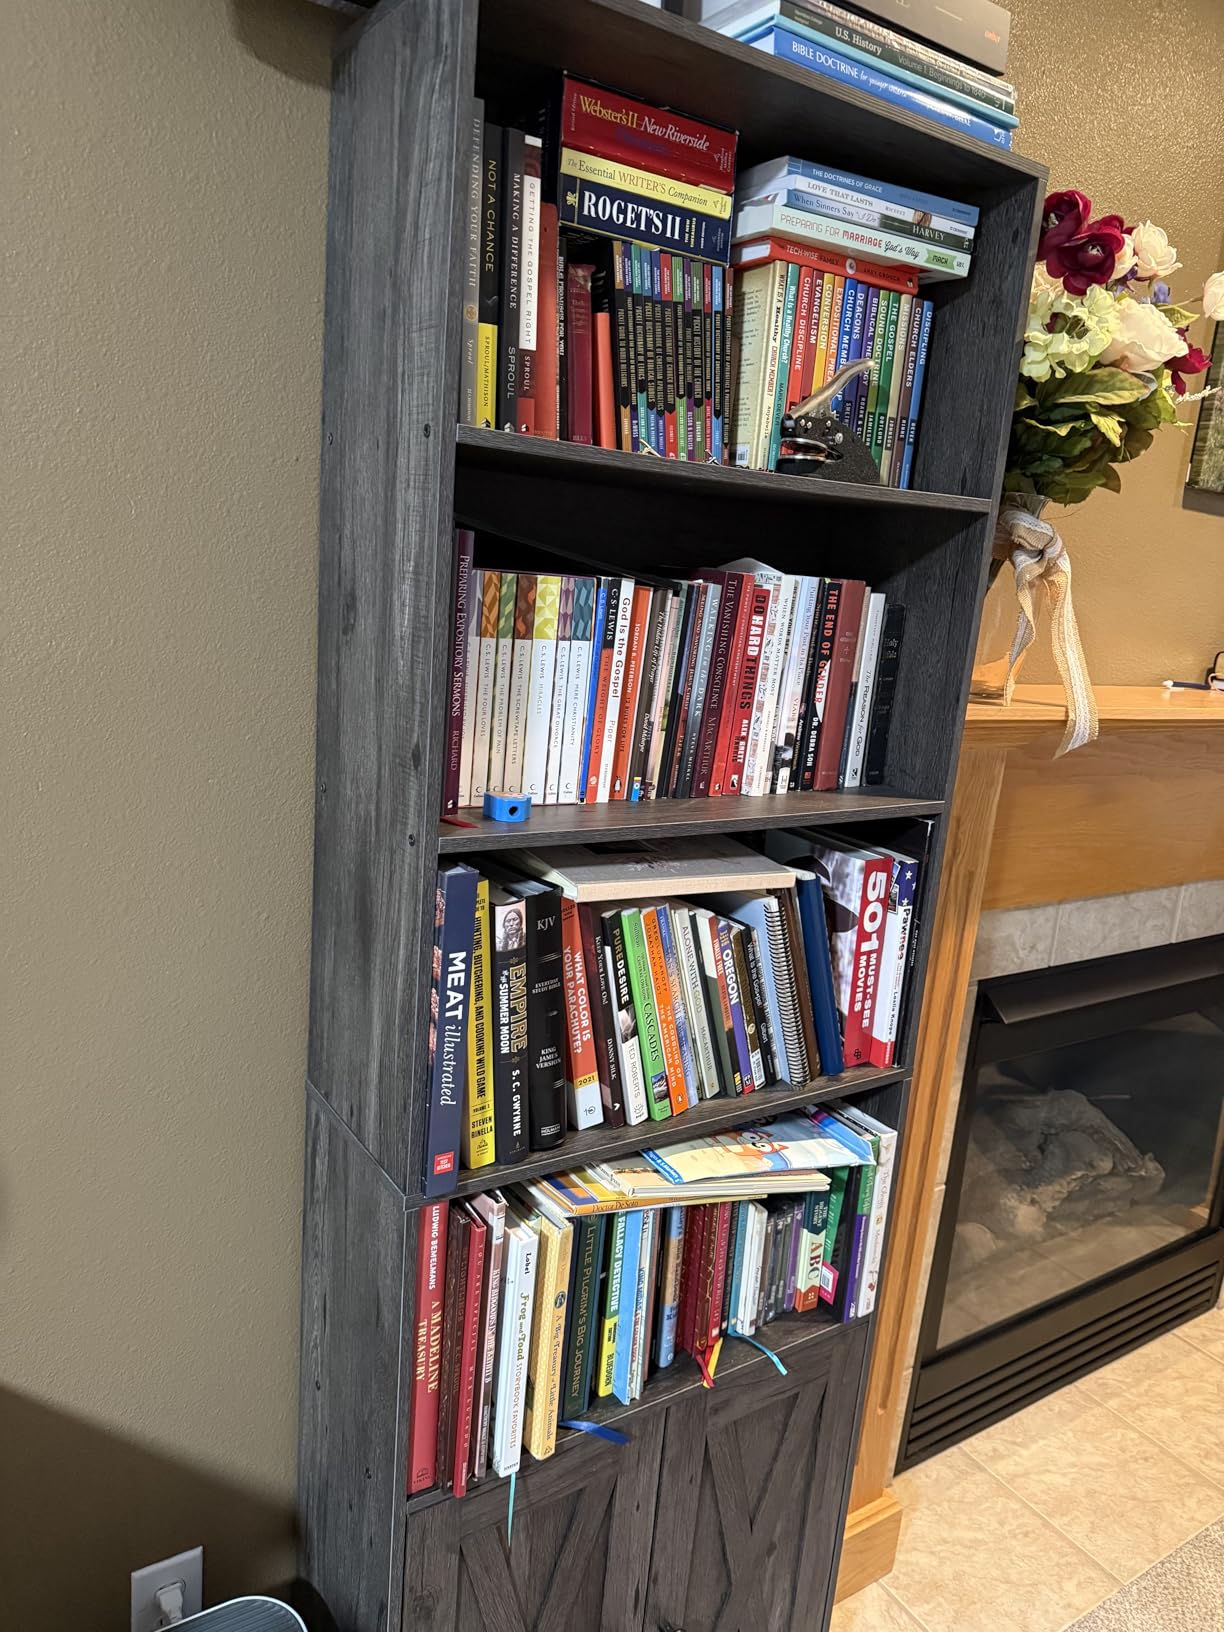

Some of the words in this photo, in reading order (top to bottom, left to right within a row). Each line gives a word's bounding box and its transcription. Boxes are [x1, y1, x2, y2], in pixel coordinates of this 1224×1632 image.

[836, 27, 850, 41] U.S.
[853, 34, 882, 56] History
[579, 95, 628, 126] Webster's
[628, 112, 637, 128] II
[640, 117, 665, 136] New
[665, 123, 710, 151] Riverside
[471, 119, 480, 199] DEFENDING
[488, 160, 496, 191] NOT
[488, 194, 495, 204] A
[512, 173, 520, 220] MAKING
[568, 158, 578, 167] The
[579, 161, 616, 180] Essential
[618, 171, 666, 194] WRITER'S
[668, 187, 708, 206] Companion
[807, 182, 828, 194] LOVE
[829, 188, 850, 200] THAT
[850, 195, 873, 207] LASTS
[813, 169, 823, 177] THE
[824, 171, 855, 185] DOCTRINES
[864, 182, 882, 193] GRACE
[470, 206, 478, 240] YOUR
[512, 222, 519, 231] A
[582, 191, 663, 235] ROGET'S
[666, 215, 681, 240] II
[912, 225, 946, 241] HARVEY
[485, 210, 495, 272] CHANCE
[780, 213, 823, 233] PREPARING
[825, 225, 841, 237] FOR
[842, 230, 882, 248] MARRIAGE
[884, 239, 903, 255] God's
[904, 245, 920, 260] Way
[787, 245, 819, 260] TECH-WISE
[820, 254, 839, 266] FAMILY
[469, 243, 477, 286] FAITH
[510, 236, 518, 309] DIFFERENCE
[800, 277, 811, 315] CHURCH
[810, 279, 822, 343] EVANGELISM
[820, 284, 832, 350] CONVERSION
[830, 287, 843, 355] EXPOSITIONAL
[853, 293, 865, 340] DEACONS
[898, 303, 909, 351] MISSIONS
[911, 308, 922, 347] CHURCH
[795, 319, 805, 370] DISCIPLINE
[885, 324, 896, 362] GOSPEL
[919, 311, 933, 365] DISCIPLING
[507, 347, 516, 399] SPROUL
[905, 351, 917, 387] ELDERS
[457, 555, 471, 609] PREPARING
[727, 580, 737, 598] THE
[827, 590, 838, 610] THE
[620, 598, 631, 621] God
[754, 595, 767, 615] DO
[454, 612, 466, 668] EXPOSITORY
[620, 625, 628, 634] Is
[718, 601, 734, 654] VANISHING
[747, 615, 764, 656] HARD
[823, 615, 834, 637] END
[617, 638, 626, 655] the
[822, 642, 831, 655] OF
[452, 670, 464, 717] SERMONS
[612, 659, 623, 698] Gospel
[710, 657, 725, 709] CONSCIENCE
[740, 657, 757, 710] THINGS
[813, 661, 827, 704] GENDER
[607, 720, 615, 743] Piper
[808, 731, 817, 752] DEBRA
[811, 717, 819, 728] DR.
[450, 730, 460, 770] RICHARD
[536, 916, 556, 931] KJV
[861, 871, 887, 951] 501
[473, 917, 483, 953] HUNTING,
[682, 926, 695, 960] ALONE
[897, 908, 911, 960] Pawnee
[563, 946, 574, 979] YOUR
[574, 952, 585, 987] WHAT
[645, 924, 656, 967] JONATHAN
[653, 971, 661, 996] HAIDT
[651, 919, 659, 941] GREG
[655, 943, 668, 992] LUKIANOFF
[688, 961, 698, 989] WITH
[715, 960, 723, 976] FREE
[445, 951, 466, 1020] MEAT
[473, 954, 484, 1004] BUTCHERING,
[723, 950, 739, 1004] OREGON
[854, 955, 867, 1012] MOVIES
[862, 953, 877, 1028] MUST-SEE
[475, 1006, 484, 1022] AND
[499, 984, 509, 1024] SUMMER
[510, 963, 528, 1053] EMPIRE
[566, 981, 582, 1053] PARACHUTE?
[578, 988, 589, 1027] COLOR
[692, 990, 702, 1013] GOD
[475, 1023, 484, 1056] COOKING
[500, 1026, 510, 1054] MOON
[581, 1030, 591, 1041] IS
[607, 1039, 615, 1063] DANNY
[643, 1003, 659, 1062] CASCADES
[668, 1024, 678, 1065] COBBLING
[676, 1068, 681, 1078] OF
[439, 1024, 461, 1106] illustrated
[476, 1057, 485, 1077] WILD
[512, 1069, 520, 1080] S.
[536, 1058, 561, 1069] VERSION
[539, 1053, 558, 1062] JAMES
[661, 1023, 672, 1064] AMERICAN
[669, 1067, 677, 1087] MIND
[477, 1079, 486, 1099] GAME
[579, 1075, 595, 1086] 2021
[630, 1062, 641, 1099] ROBERTS
[471, 1117, 492, 1128] STEVEN
[513, 1095, 522, 1137] GWYNNE
[430, 1206, 440, 1238] LUDWIG
[614, 1218, 625, 1258] FALLACY
[428, 1240, 438, 1290] BEMELMANS
[524, 1252, 532, 1275] Lobel
[584, 1227, 597, 1265] LITTLE
[807, 1241, 823, 1280] ABC
[518, 1292, 529, 1321] Frog
[578, 1267, 592, 1324] PILGRIM'S
[610, 1262, 621, 1312] DETECTIVE
[415, 1319, 428, 1381] TREASURY
[427, 1312, 442, 1393] MADELINE
[516, 1334, 527, 1361] Toad
[577, 1326, 586, 1346] BIG
[512, 1363, 523, 1408] STORYBOOK
[571, 1348, 584, 1397] JOURNEY
[604, 1353, 614, 1387] BLUEDORN
[509, 1410, 519, 1449] FAVORITES
